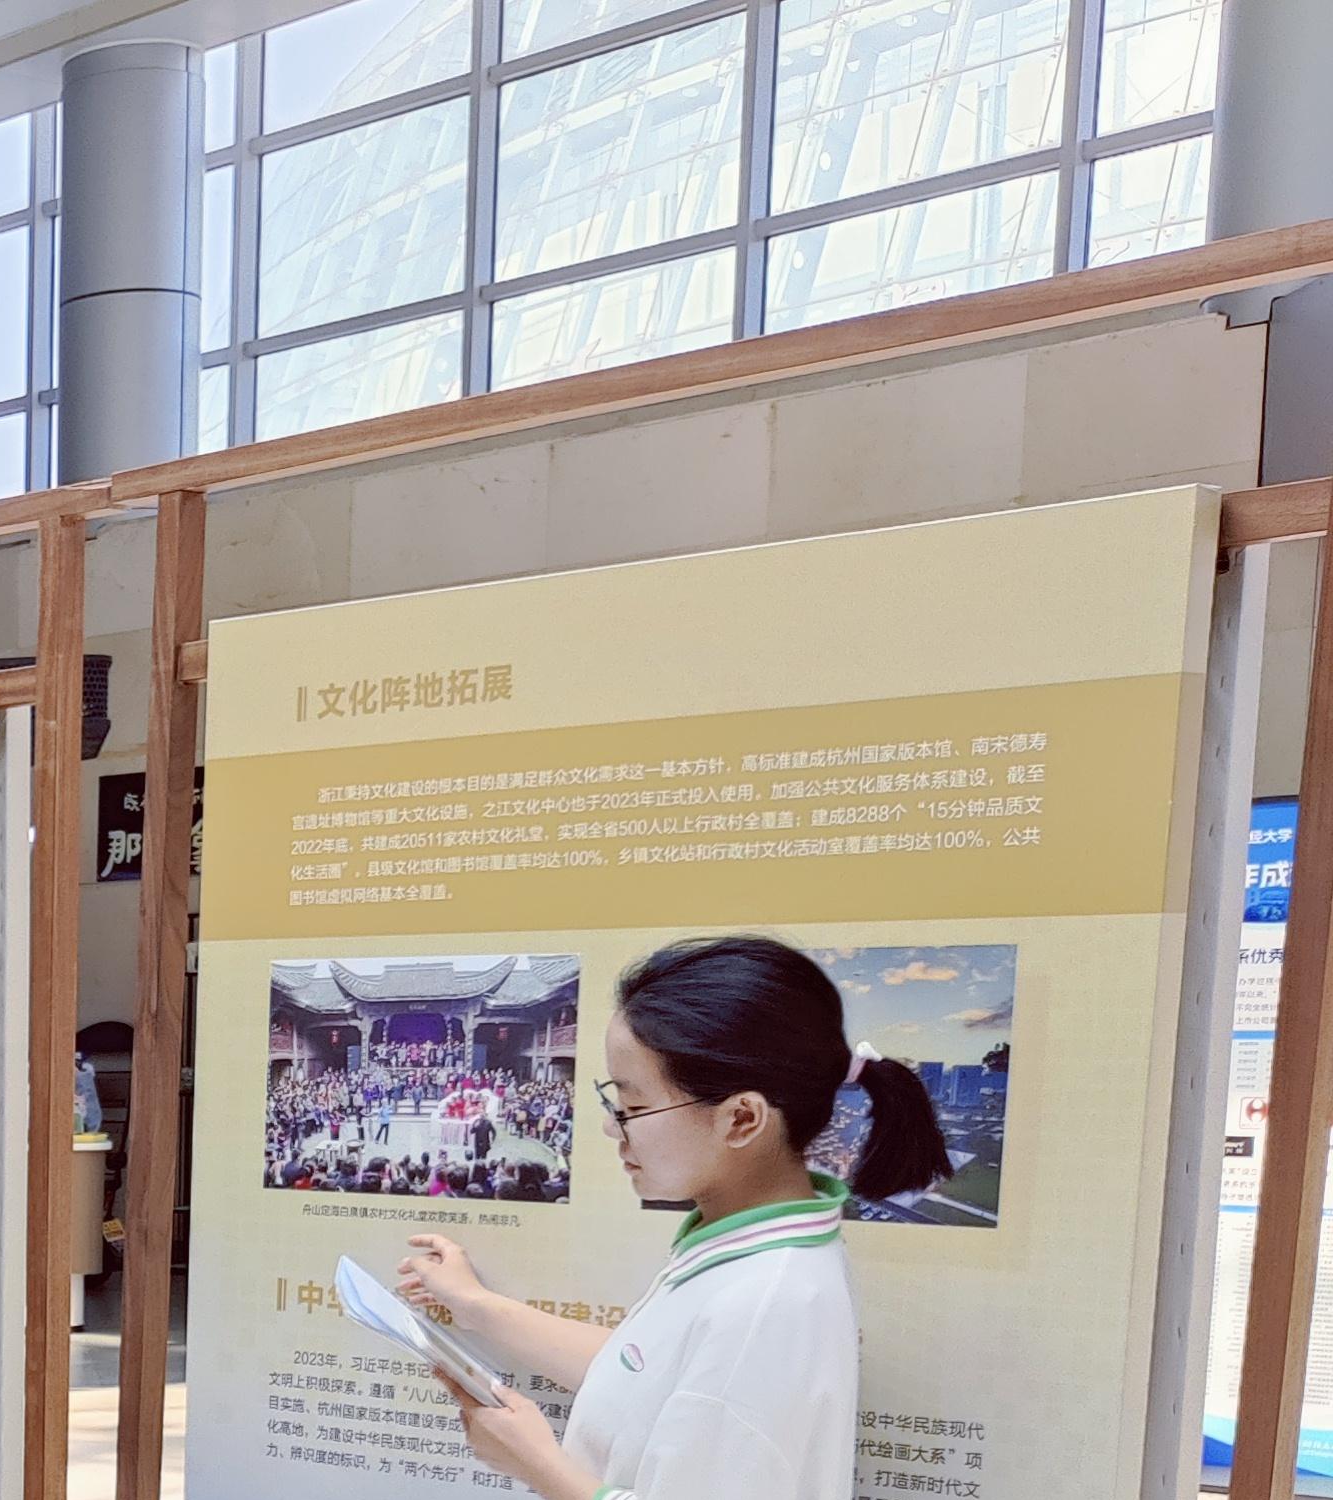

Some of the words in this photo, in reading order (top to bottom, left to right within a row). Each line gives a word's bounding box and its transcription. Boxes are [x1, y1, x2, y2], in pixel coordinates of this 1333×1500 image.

[316, 664, 513, 720] 文化阵地拓展
[268, 1395, 465, 1433] 目实施、杭州国家版本馆建设等成
[857, 1410, 985, 1441] 设中华民族现代
[855, 1438, 983, 1470] 代绘画大系”项
[854, 1468, 980, 1499] ，打造新时代文
